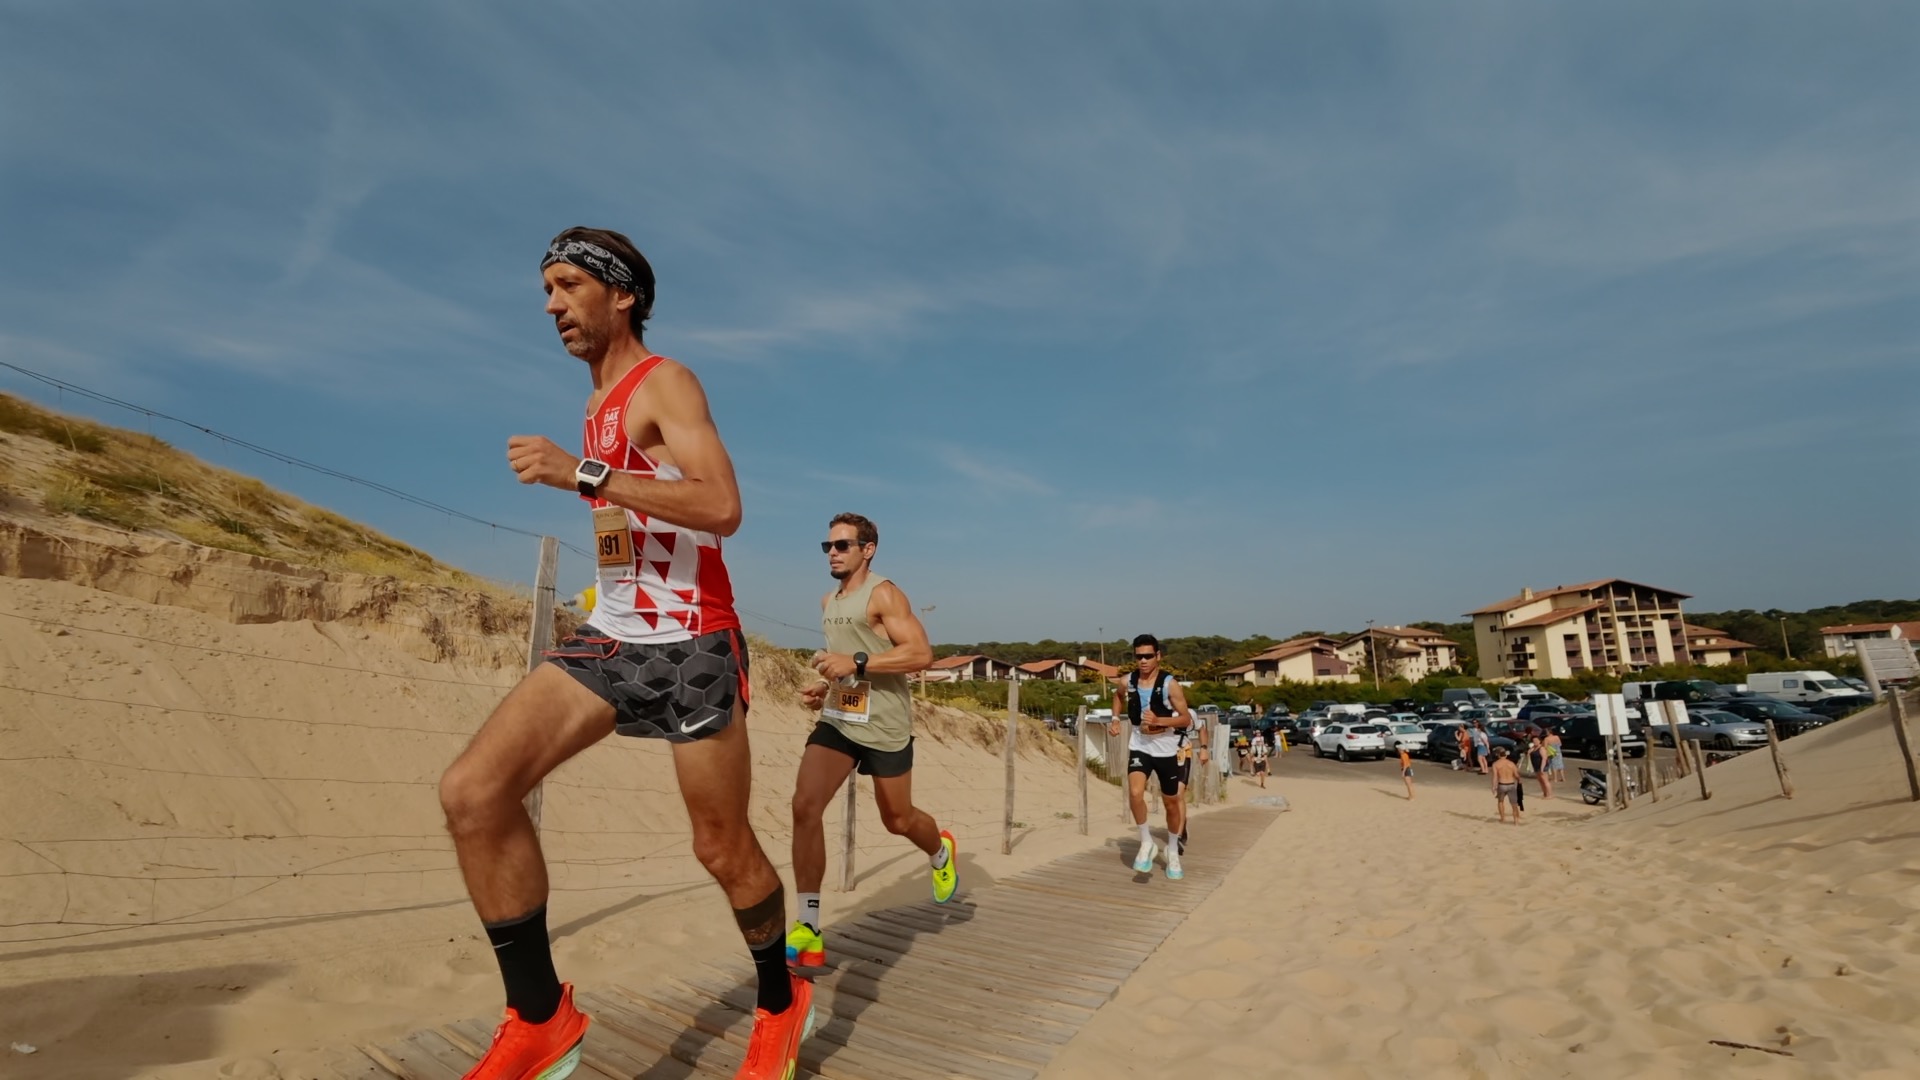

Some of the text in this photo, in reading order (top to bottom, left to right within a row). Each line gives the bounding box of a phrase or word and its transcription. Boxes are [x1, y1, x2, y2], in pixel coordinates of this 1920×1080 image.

[604, 410, 619, 423] DAX
[599, 534, 620, 556] 891
[841, 694, 859, 708] 946
